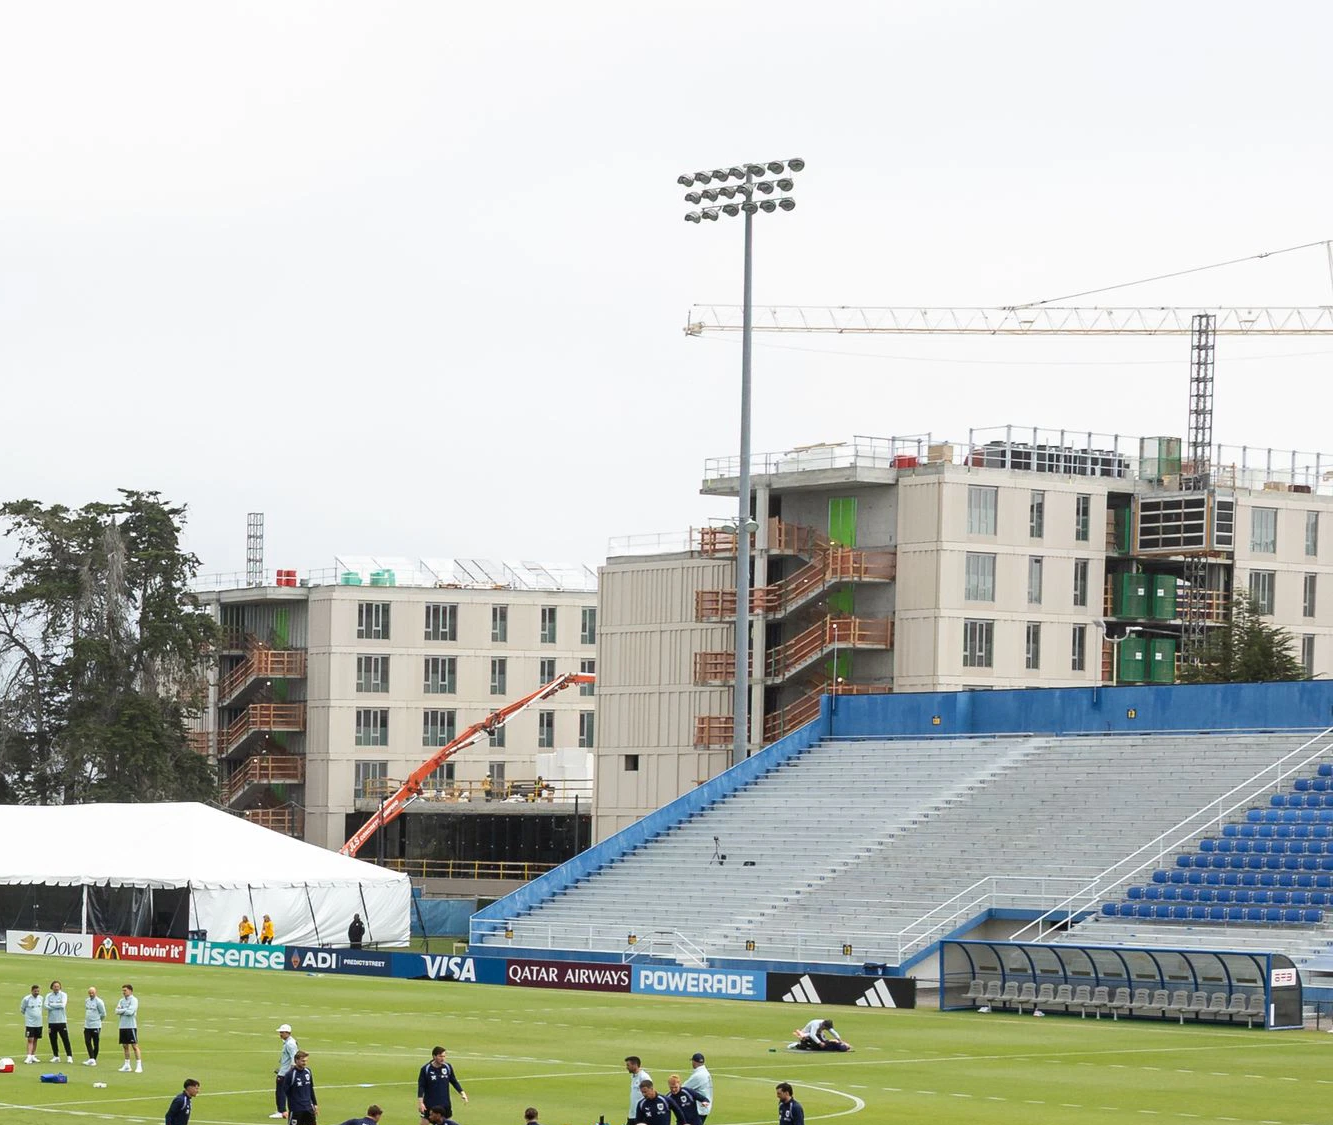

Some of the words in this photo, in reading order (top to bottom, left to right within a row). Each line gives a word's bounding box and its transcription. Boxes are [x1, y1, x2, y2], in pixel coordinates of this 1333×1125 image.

[349, 836, 360, 852] JLS
[43, 934, 83, 956] Dove
[121, 942, 138, 956] i'm
[140, 943, 169, 957] lovin'
[185, 940, 284, 969] Hisense
[302, 951, 336, 969] ADI
[343, 958, 385, 968] PREDICTSTREET
[421, 955, 476, 982] VISA
[508, 965, 559, 982] QATAR
[564, 968, 629, 986] AIRWAYS
[639, 970, 755, 995] POWERADE
